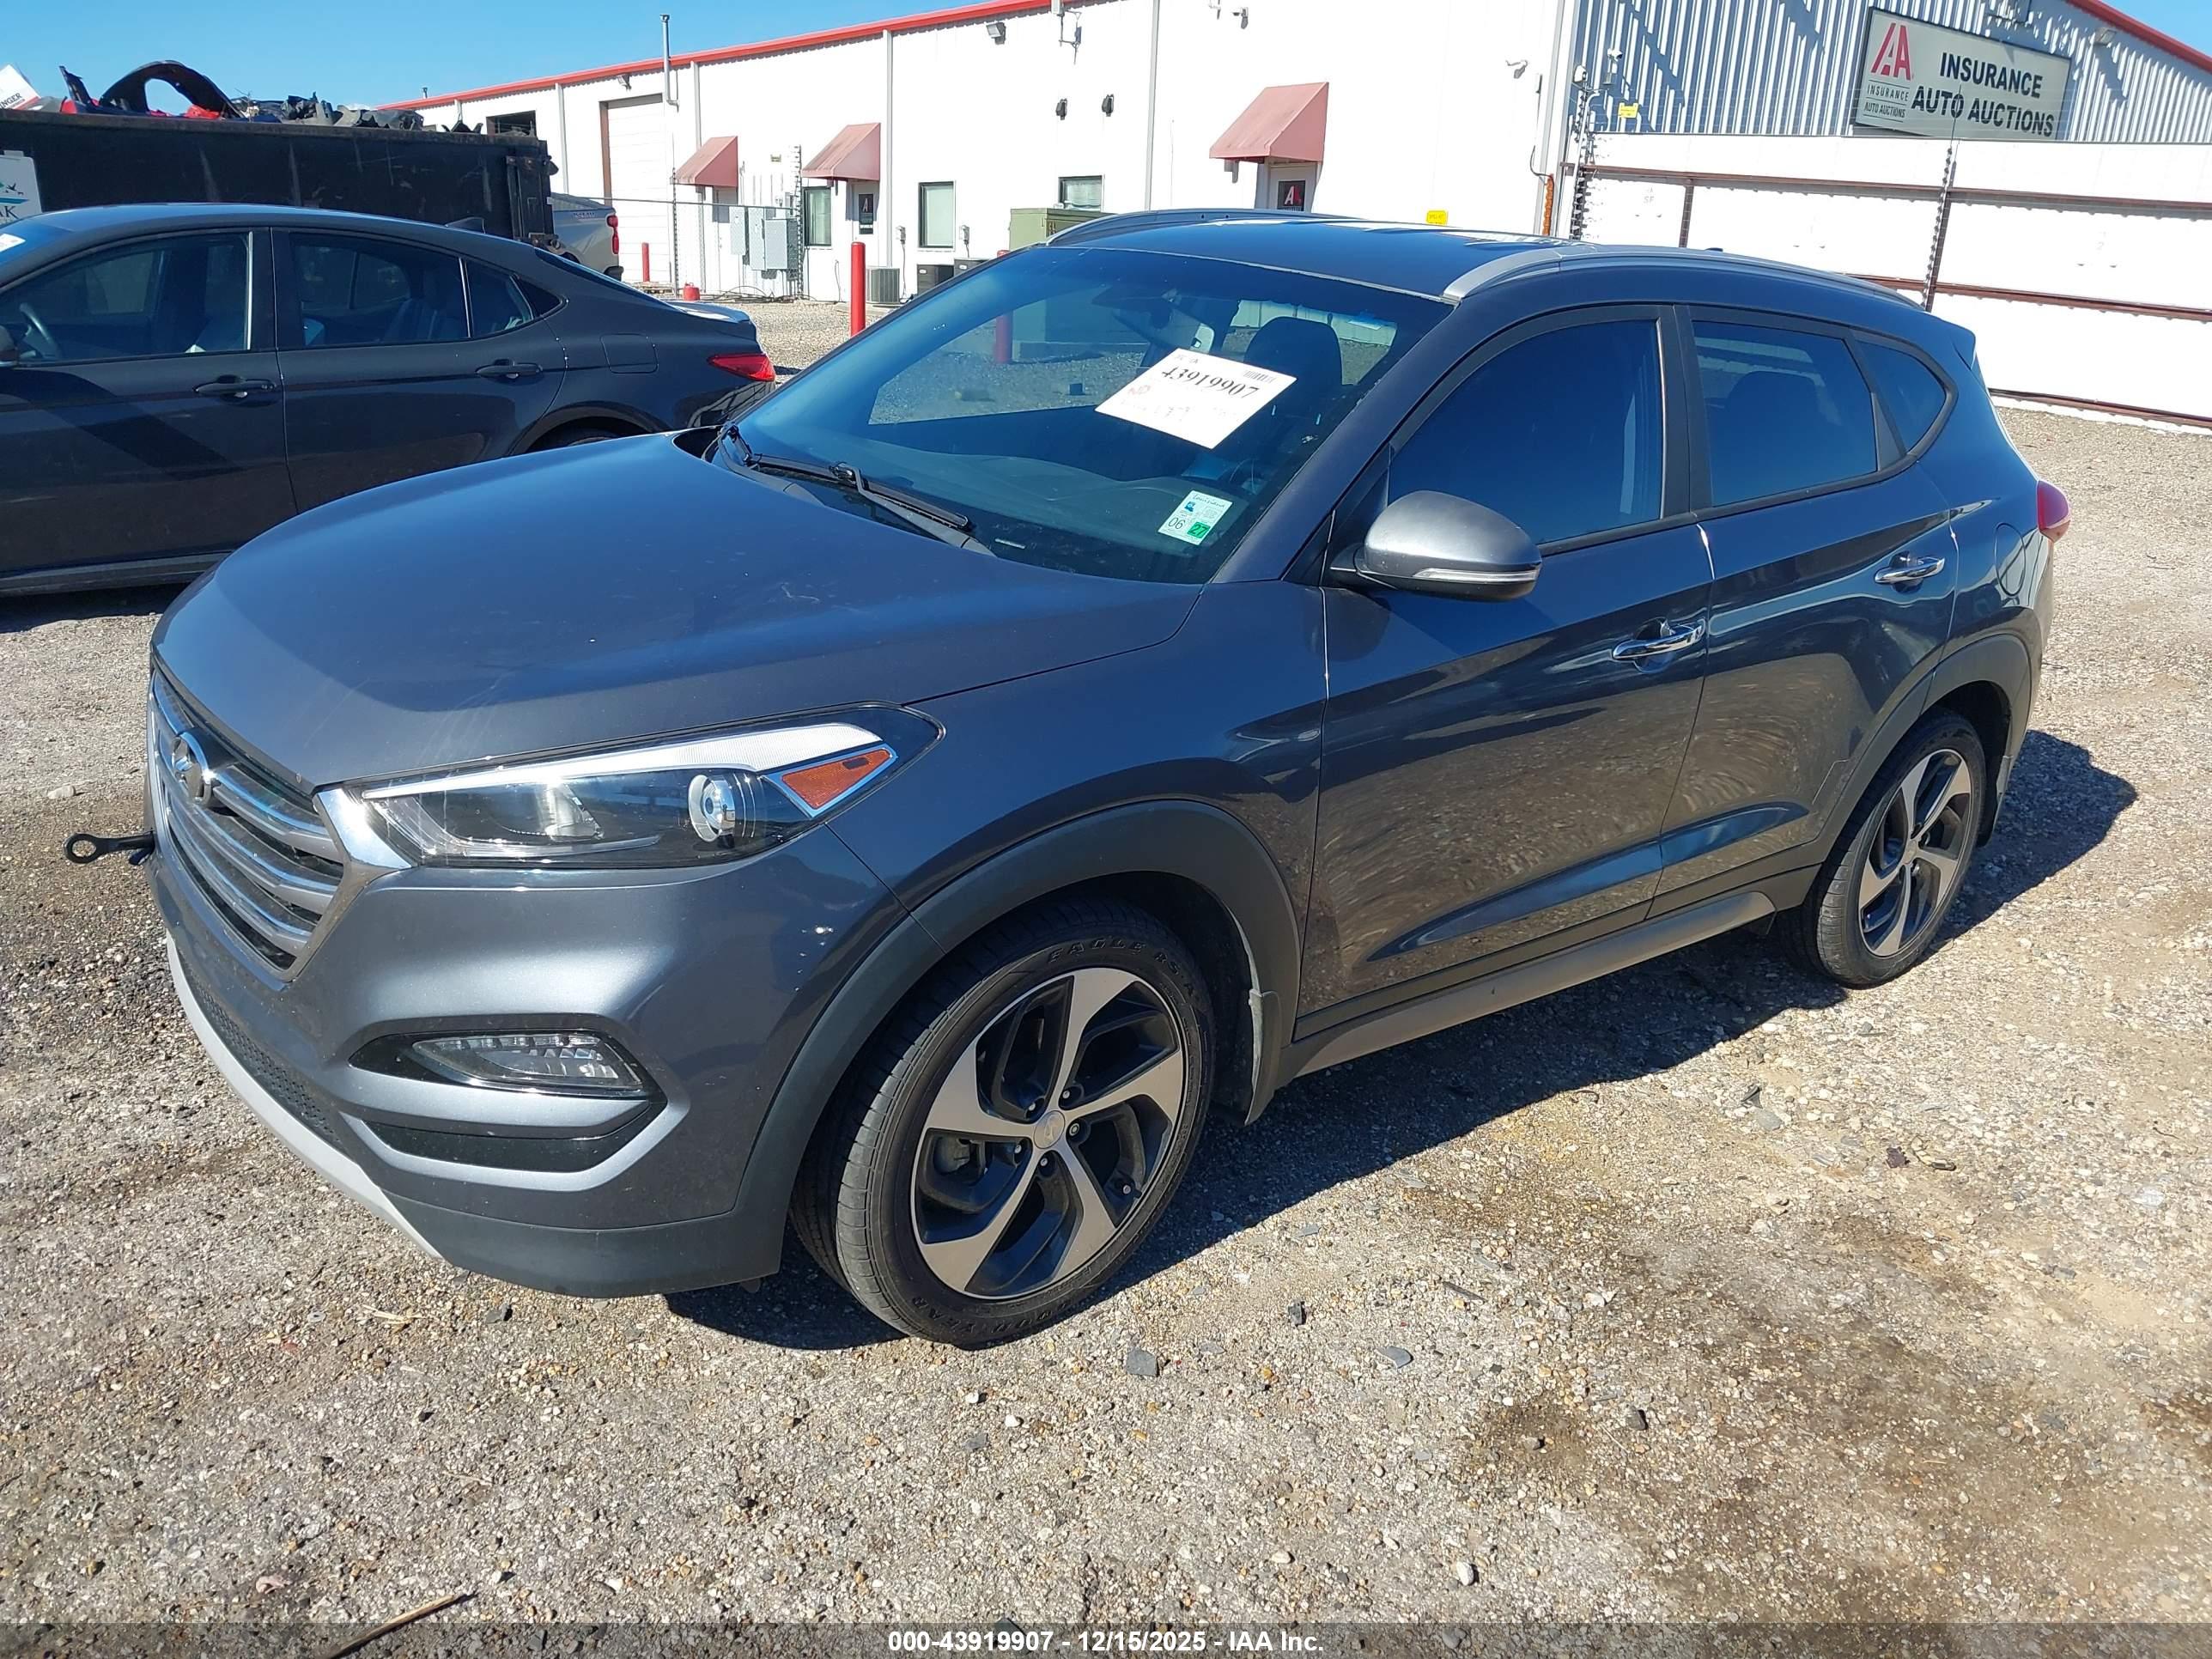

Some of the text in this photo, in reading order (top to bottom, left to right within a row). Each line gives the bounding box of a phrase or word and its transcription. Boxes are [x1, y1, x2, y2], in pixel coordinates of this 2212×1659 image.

[1940, 52, 2043, 98] INSURANCE
[1867, 84, 1909, 101] INSURANCE
[1864, 101, 1905, 118] AUTO AUCTIONS
[1911, 86, 2054, 137] AUTO AUCTIONS
[1161, 366, 1260, 399] 43919907
[1169, 517, 1185, 529] 06
[1190, 524, 1207, 538] 27
